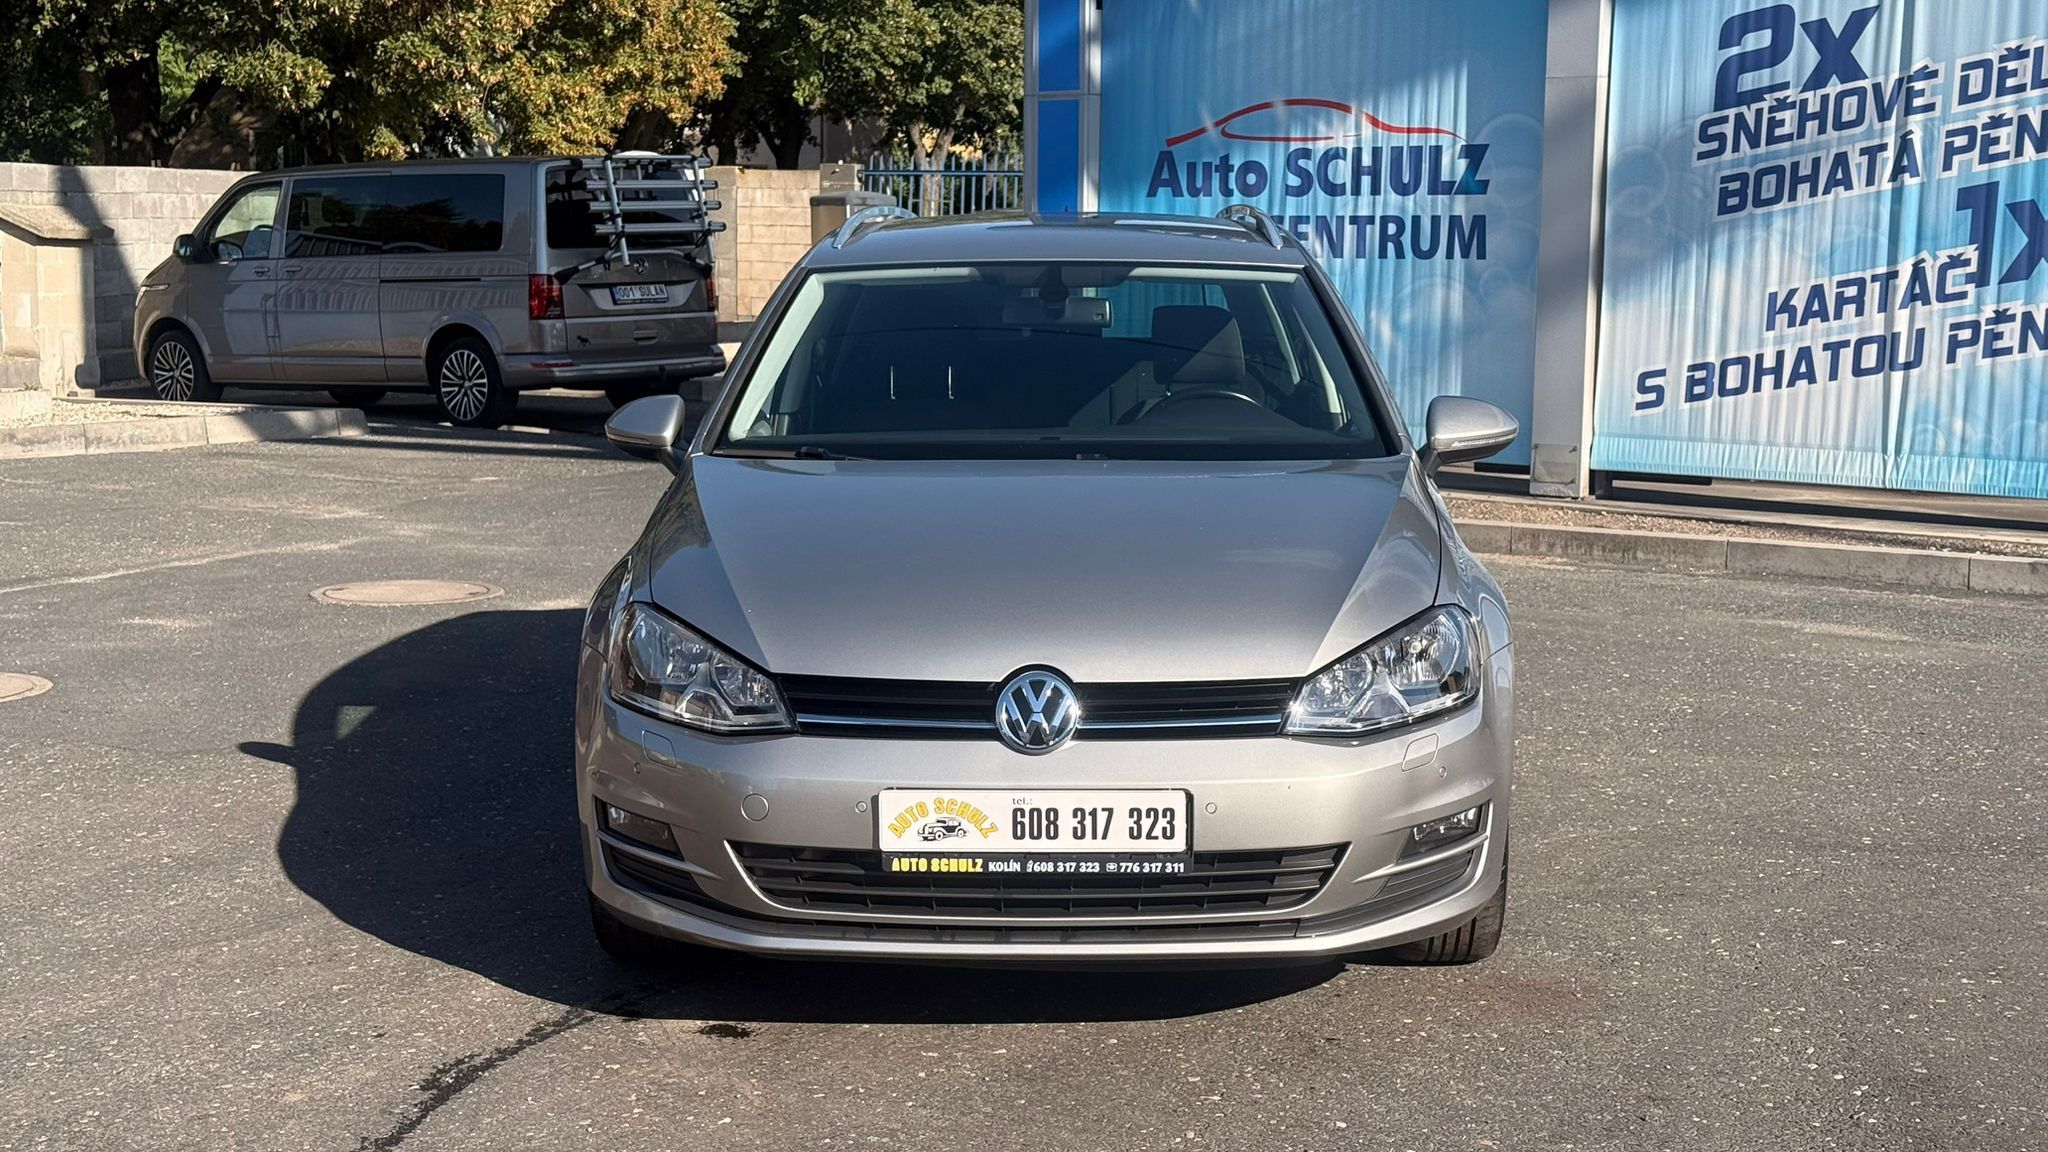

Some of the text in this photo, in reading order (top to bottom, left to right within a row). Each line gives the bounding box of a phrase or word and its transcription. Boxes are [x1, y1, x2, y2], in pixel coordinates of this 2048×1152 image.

[1714, 4, 1880, 112] 2x
[1697, 64, 1940, 160] SNĚHOVÉ
[1146, 143, 1490, 198] Auto SCHULZ
[1717, 129, 1920, 216] BOHATÁ
[1270, 215, 1487, 260] ENTRUM
[1766, 253, 1972, 332] KARTÁČ
[1635, 368, 1667, 411] S
[1684, 327, 1926, 404] BOHATOU
[888, 797, 998, 839] AUTO SCHULZ
[1012, 807, 1176, 841] 608 317 323
[891, 857, 1185, 874] AUTO SCHULZ KOLÍN 608 317 323 776 317 311
